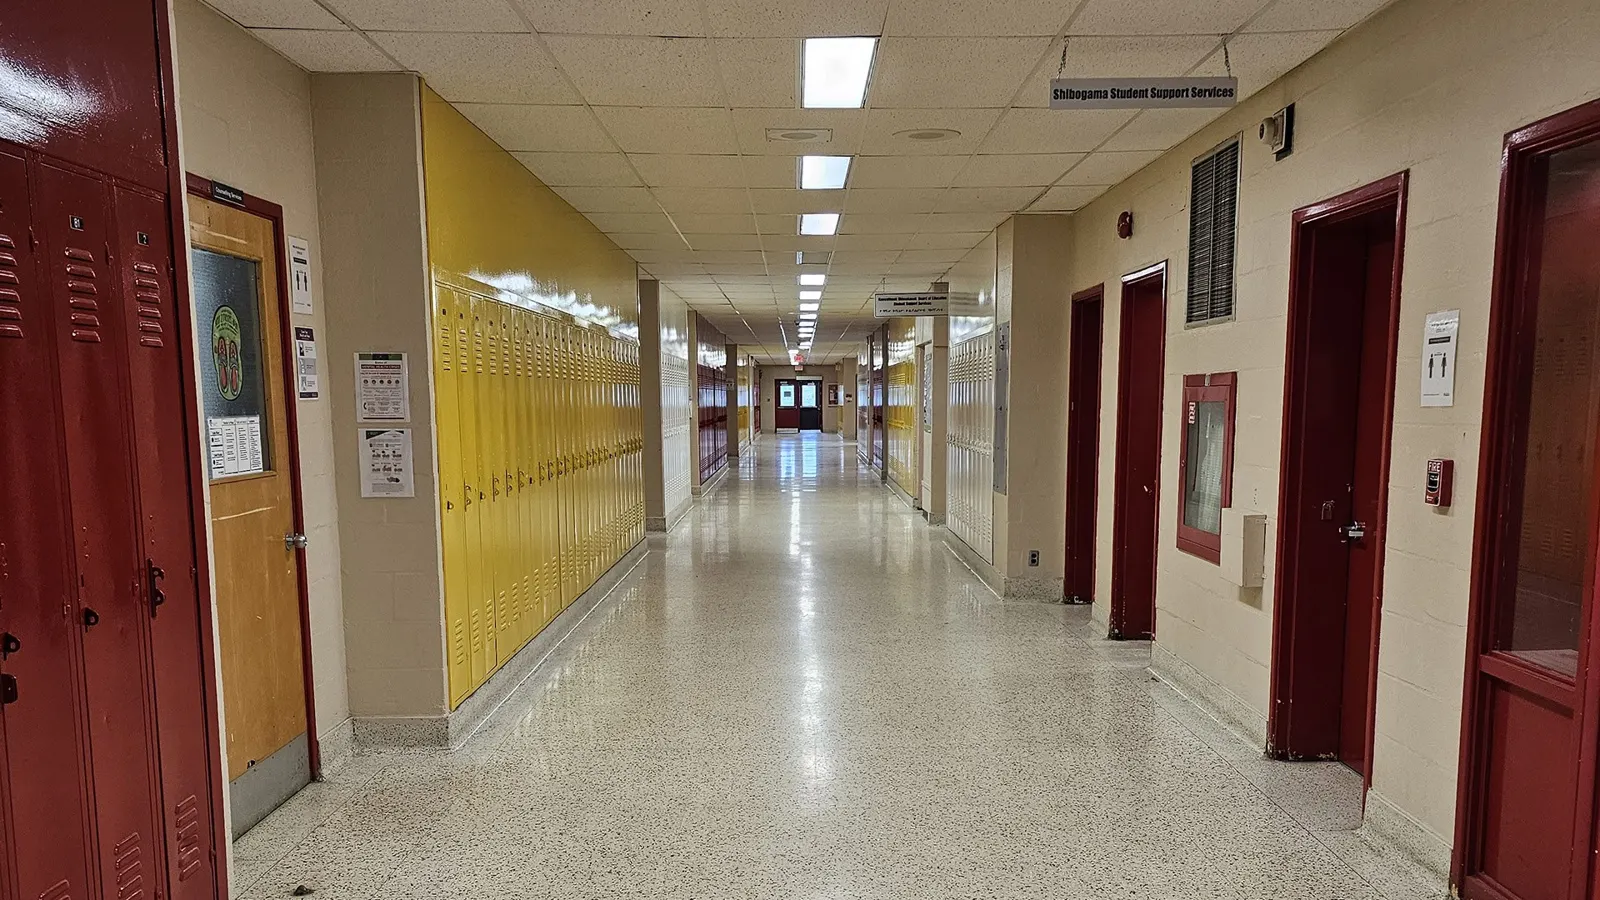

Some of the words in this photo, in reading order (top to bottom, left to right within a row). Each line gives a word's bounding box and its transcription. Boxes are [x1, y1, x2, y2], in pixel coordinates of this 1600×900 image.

[1053, 88, 1108, 100] Shibogama
[1110, 87, 1149, 99] Student
[1150, 86, 1189, 100] Support
[1190, 86, 1234, 98] Services
[1428, 461, 1440, 472] FIRE
